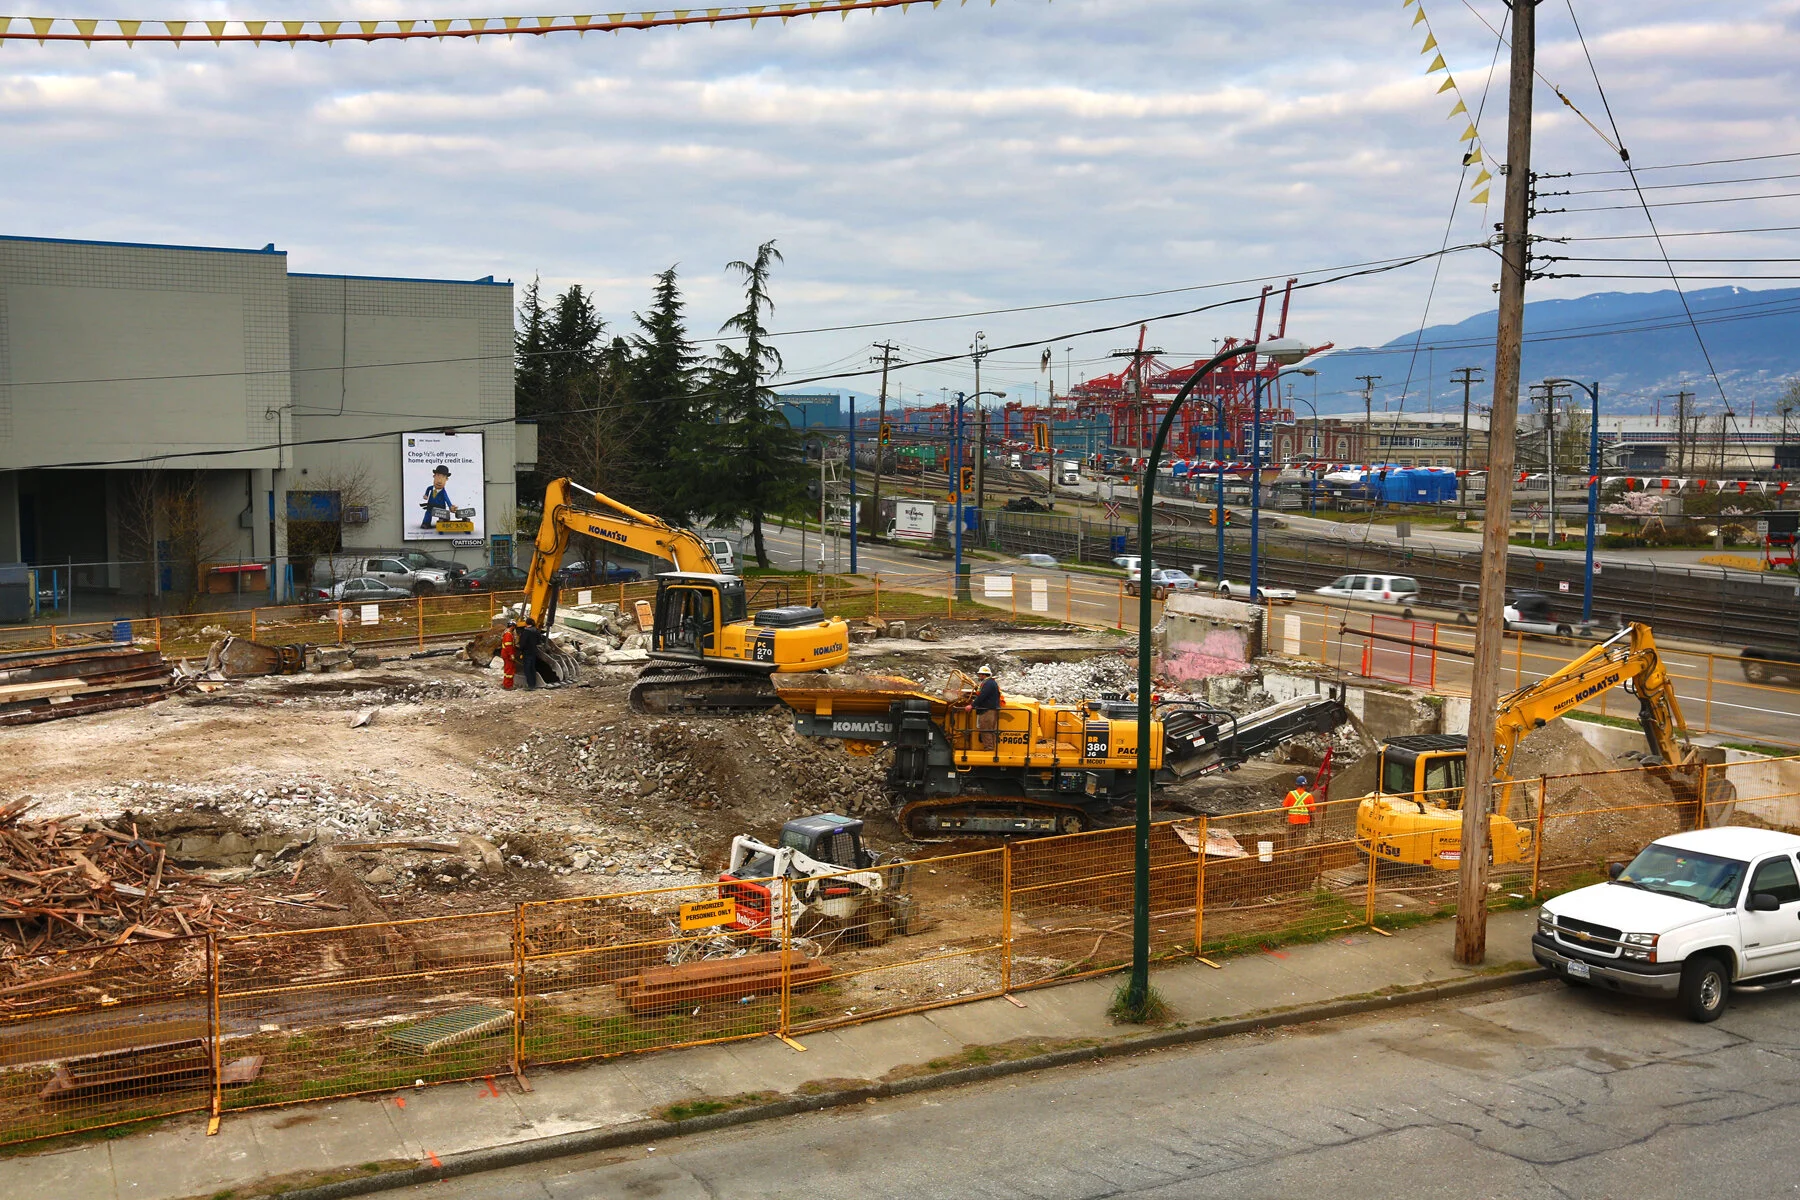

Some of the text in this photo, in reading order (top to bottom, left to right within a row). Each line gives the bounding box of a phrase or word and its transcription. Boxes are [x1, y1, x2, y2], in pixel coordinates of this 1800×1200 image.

[588, 524, 628, 542] KOMATSU
[814, 642, 842, 656] KOMATSU
[1554, 673, 1620, 712] PACIFIC KOMATSU
[832, 720, 893, 732] KOMATSU
[1087, 743, 1107, 752] 380
[691, 902, 724, 912] AUTHORIZED
[686, 911, 716, 921] PERSONNEL
